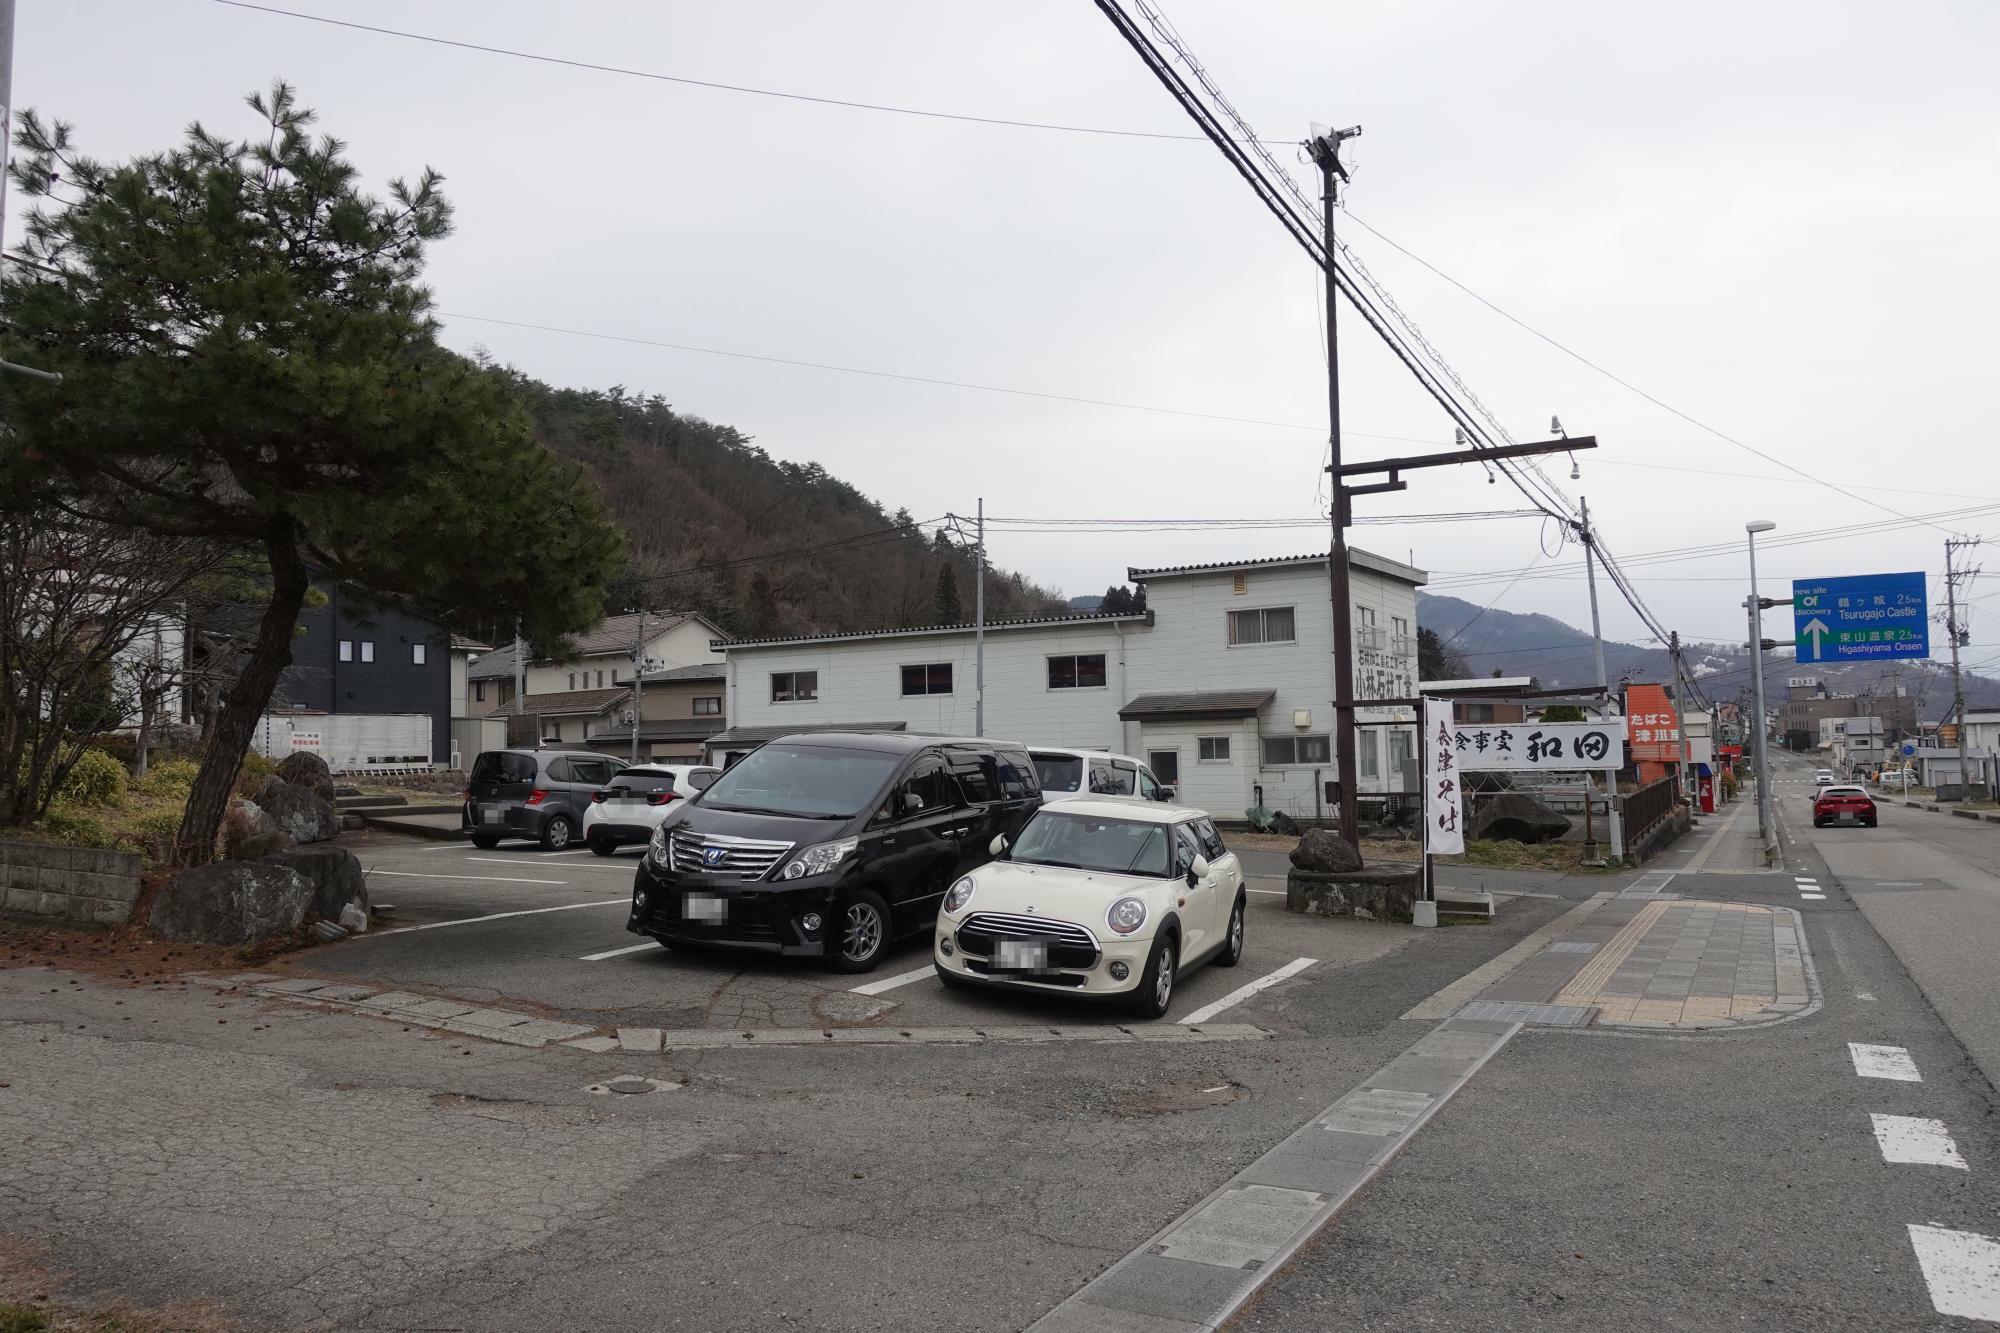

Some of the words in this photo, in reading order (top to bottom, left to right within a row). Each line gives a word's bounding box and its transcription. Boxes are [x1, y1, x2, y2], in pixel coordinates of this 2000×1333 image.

[1813, 586, 1827, 594] site
[1838, 609, 1885, 620] Tsurugajo
[1887, 606, 1917, 617] Castle
[1840, 630, 1896, 643] 東山温泉
[1839, 643, 1892, 654] Higashiyama
[1895, 642, 1923, 651] Onsen
[1355, 667, 1412, 700] 小林石材工業
[1631, 713, 1671, 726] たばこ
[1526, 731, 1610, 763] 和田
[1436, 720, 1460, 834] 会津そば
